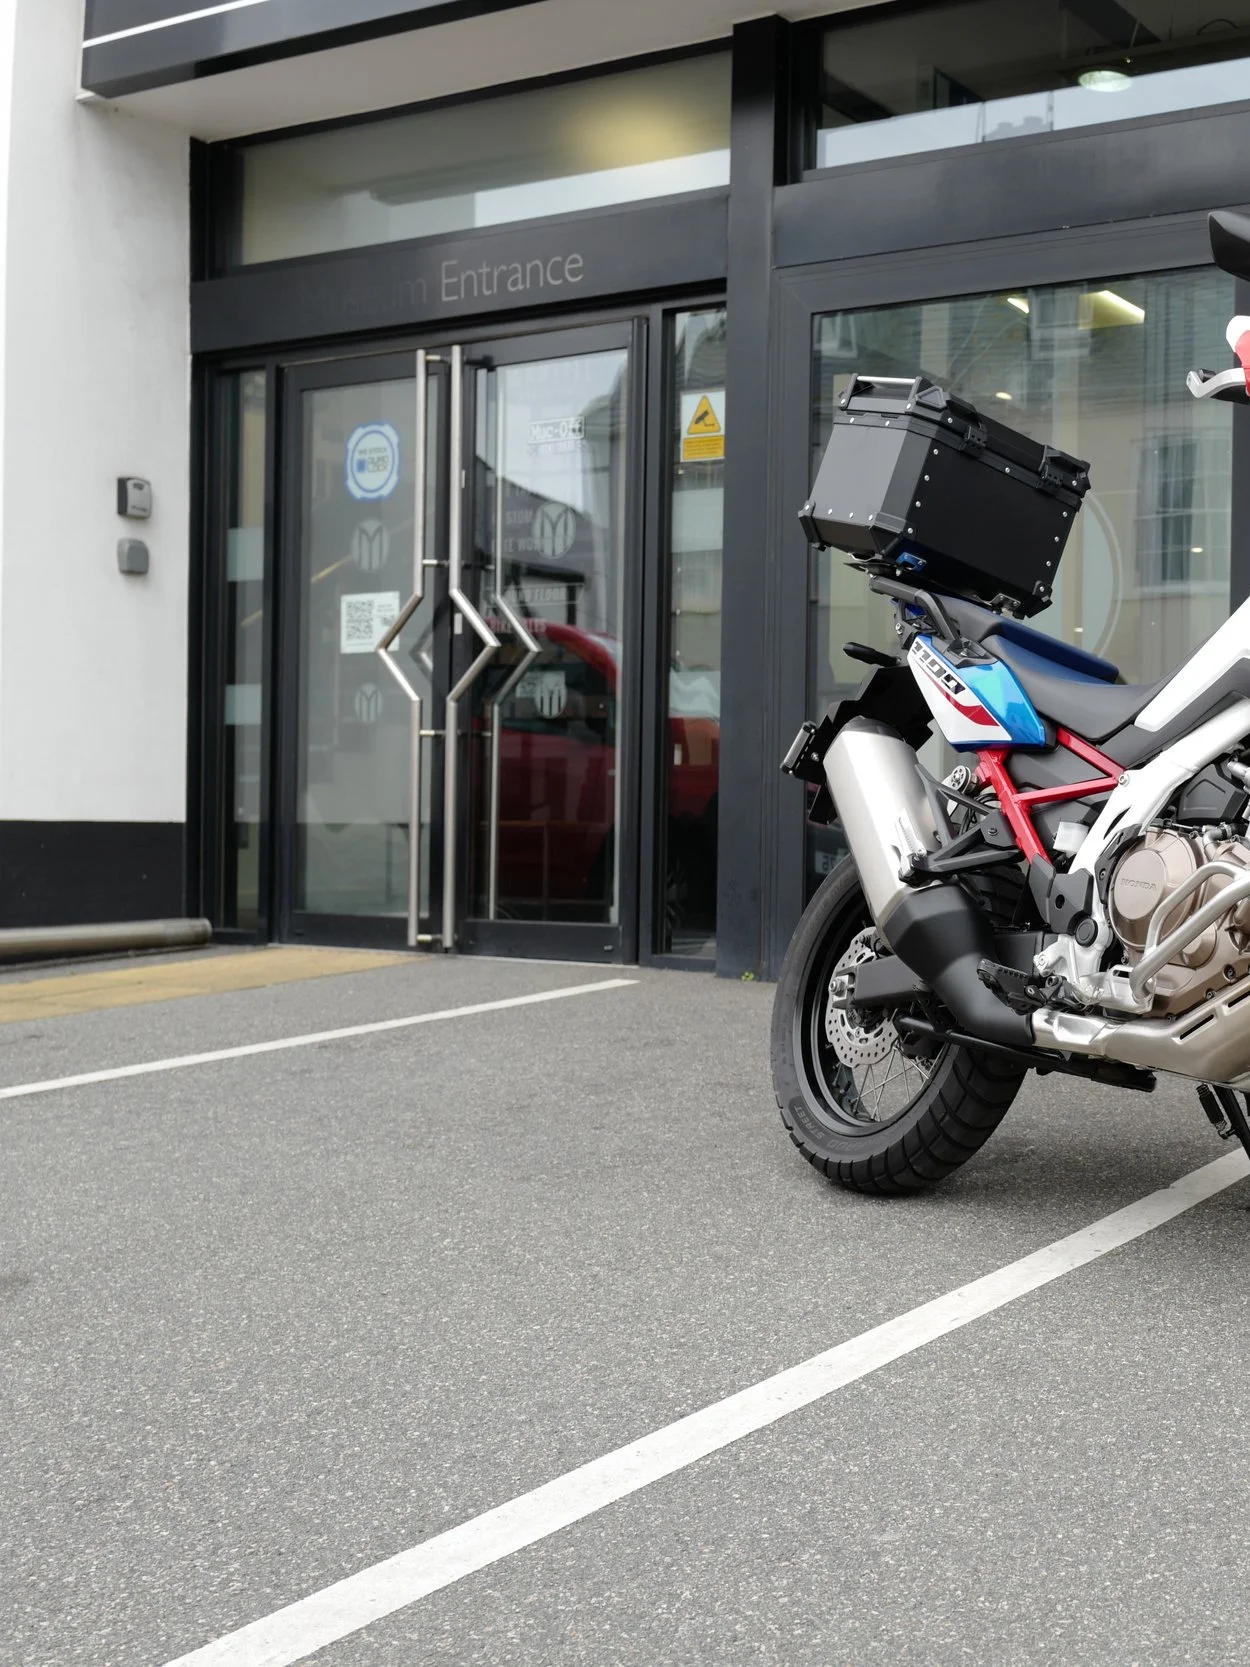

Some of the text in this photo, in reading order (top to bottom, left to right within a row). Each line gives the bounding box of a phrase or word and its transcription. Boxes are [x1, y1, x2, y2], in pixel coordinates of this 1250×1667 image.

[441, 253, 584, 302] Entrance
[911, 641, 966, 695] 1100
[1120, 878, 1157, 891] HONDA
[793, 1105, 826, 1140] STREET
